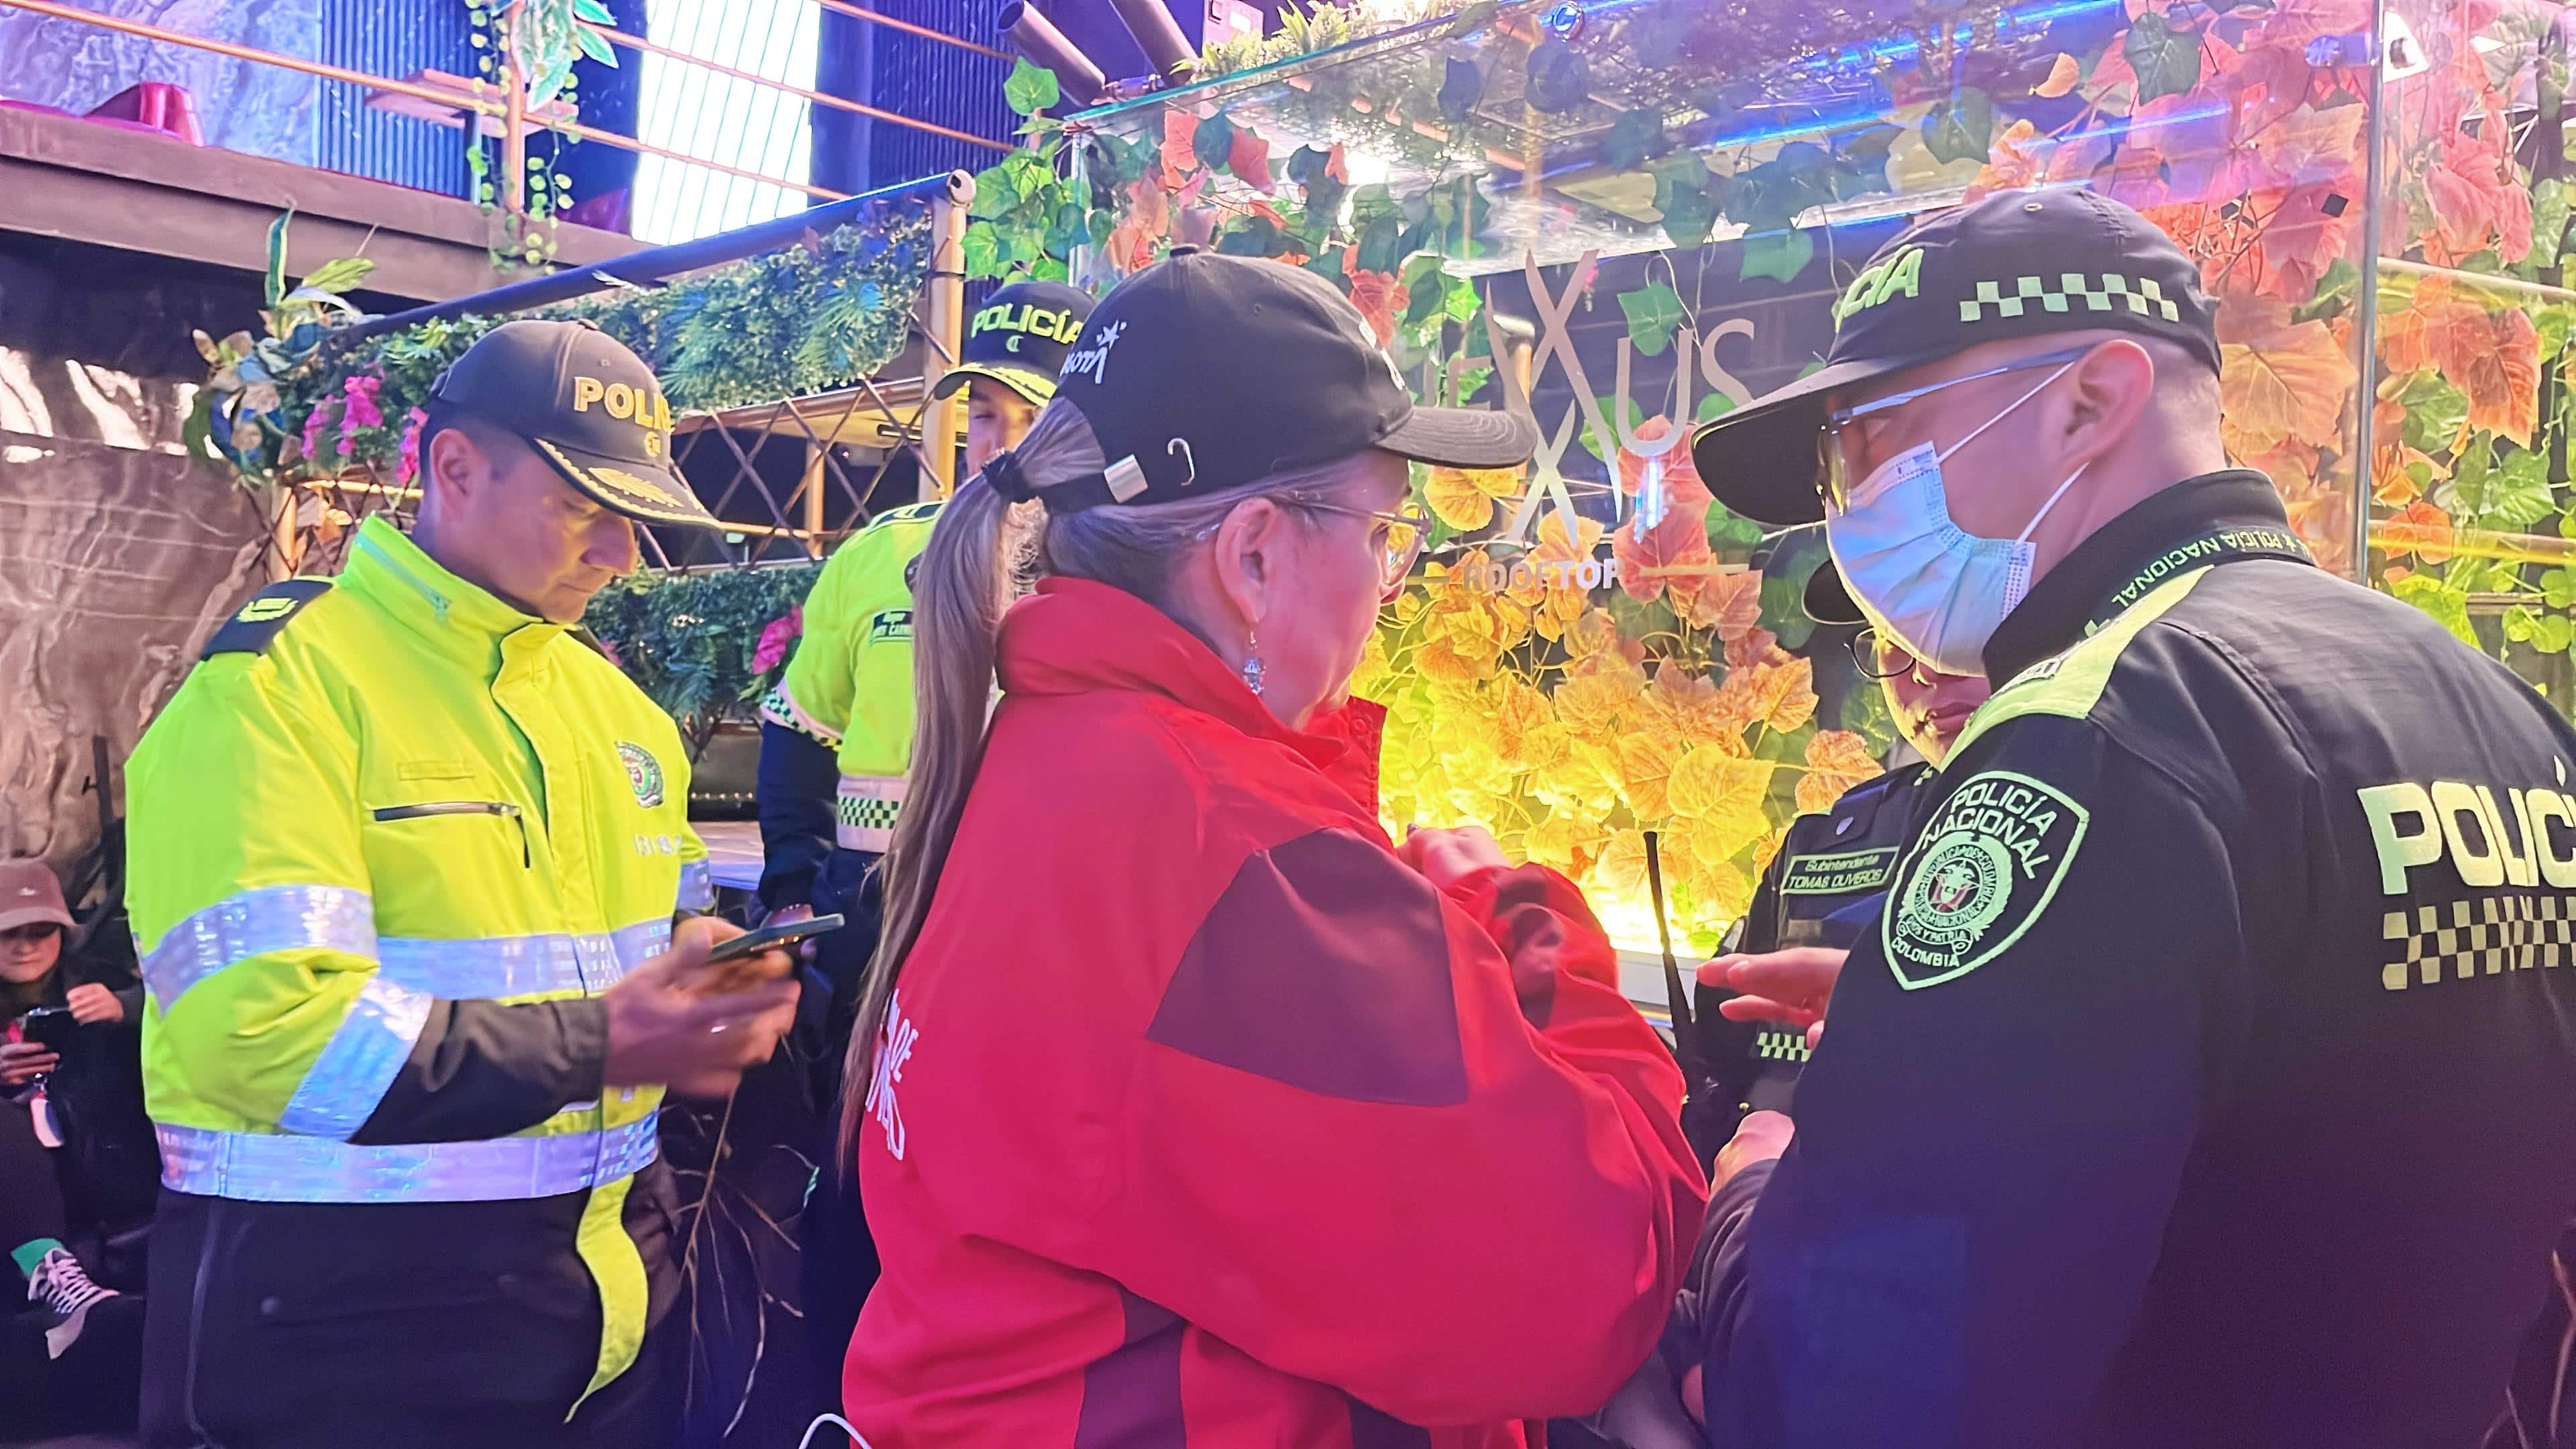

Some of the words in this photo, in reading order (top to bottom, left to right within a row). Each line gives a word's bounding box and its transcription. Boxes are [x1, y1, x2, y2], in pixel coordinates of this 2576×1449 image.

[971, 303, 1085, 344] POLICÍA
[1463, 559, 1619, 592] ROOFTOP
[2111, 537, 2221, 608] NACIONAL
[1950, 782, 2057, 837] POLICÍA
[2356, 754, 2576, 896] POLIC
[1922, 807, 2050, 880] NACIONAL
[1788, 875, 1829, 889] TOMAS
[1831, 868, 1883, 888] OLIVEROS
[1891, 936, 1960, 967] COLOMBIA
